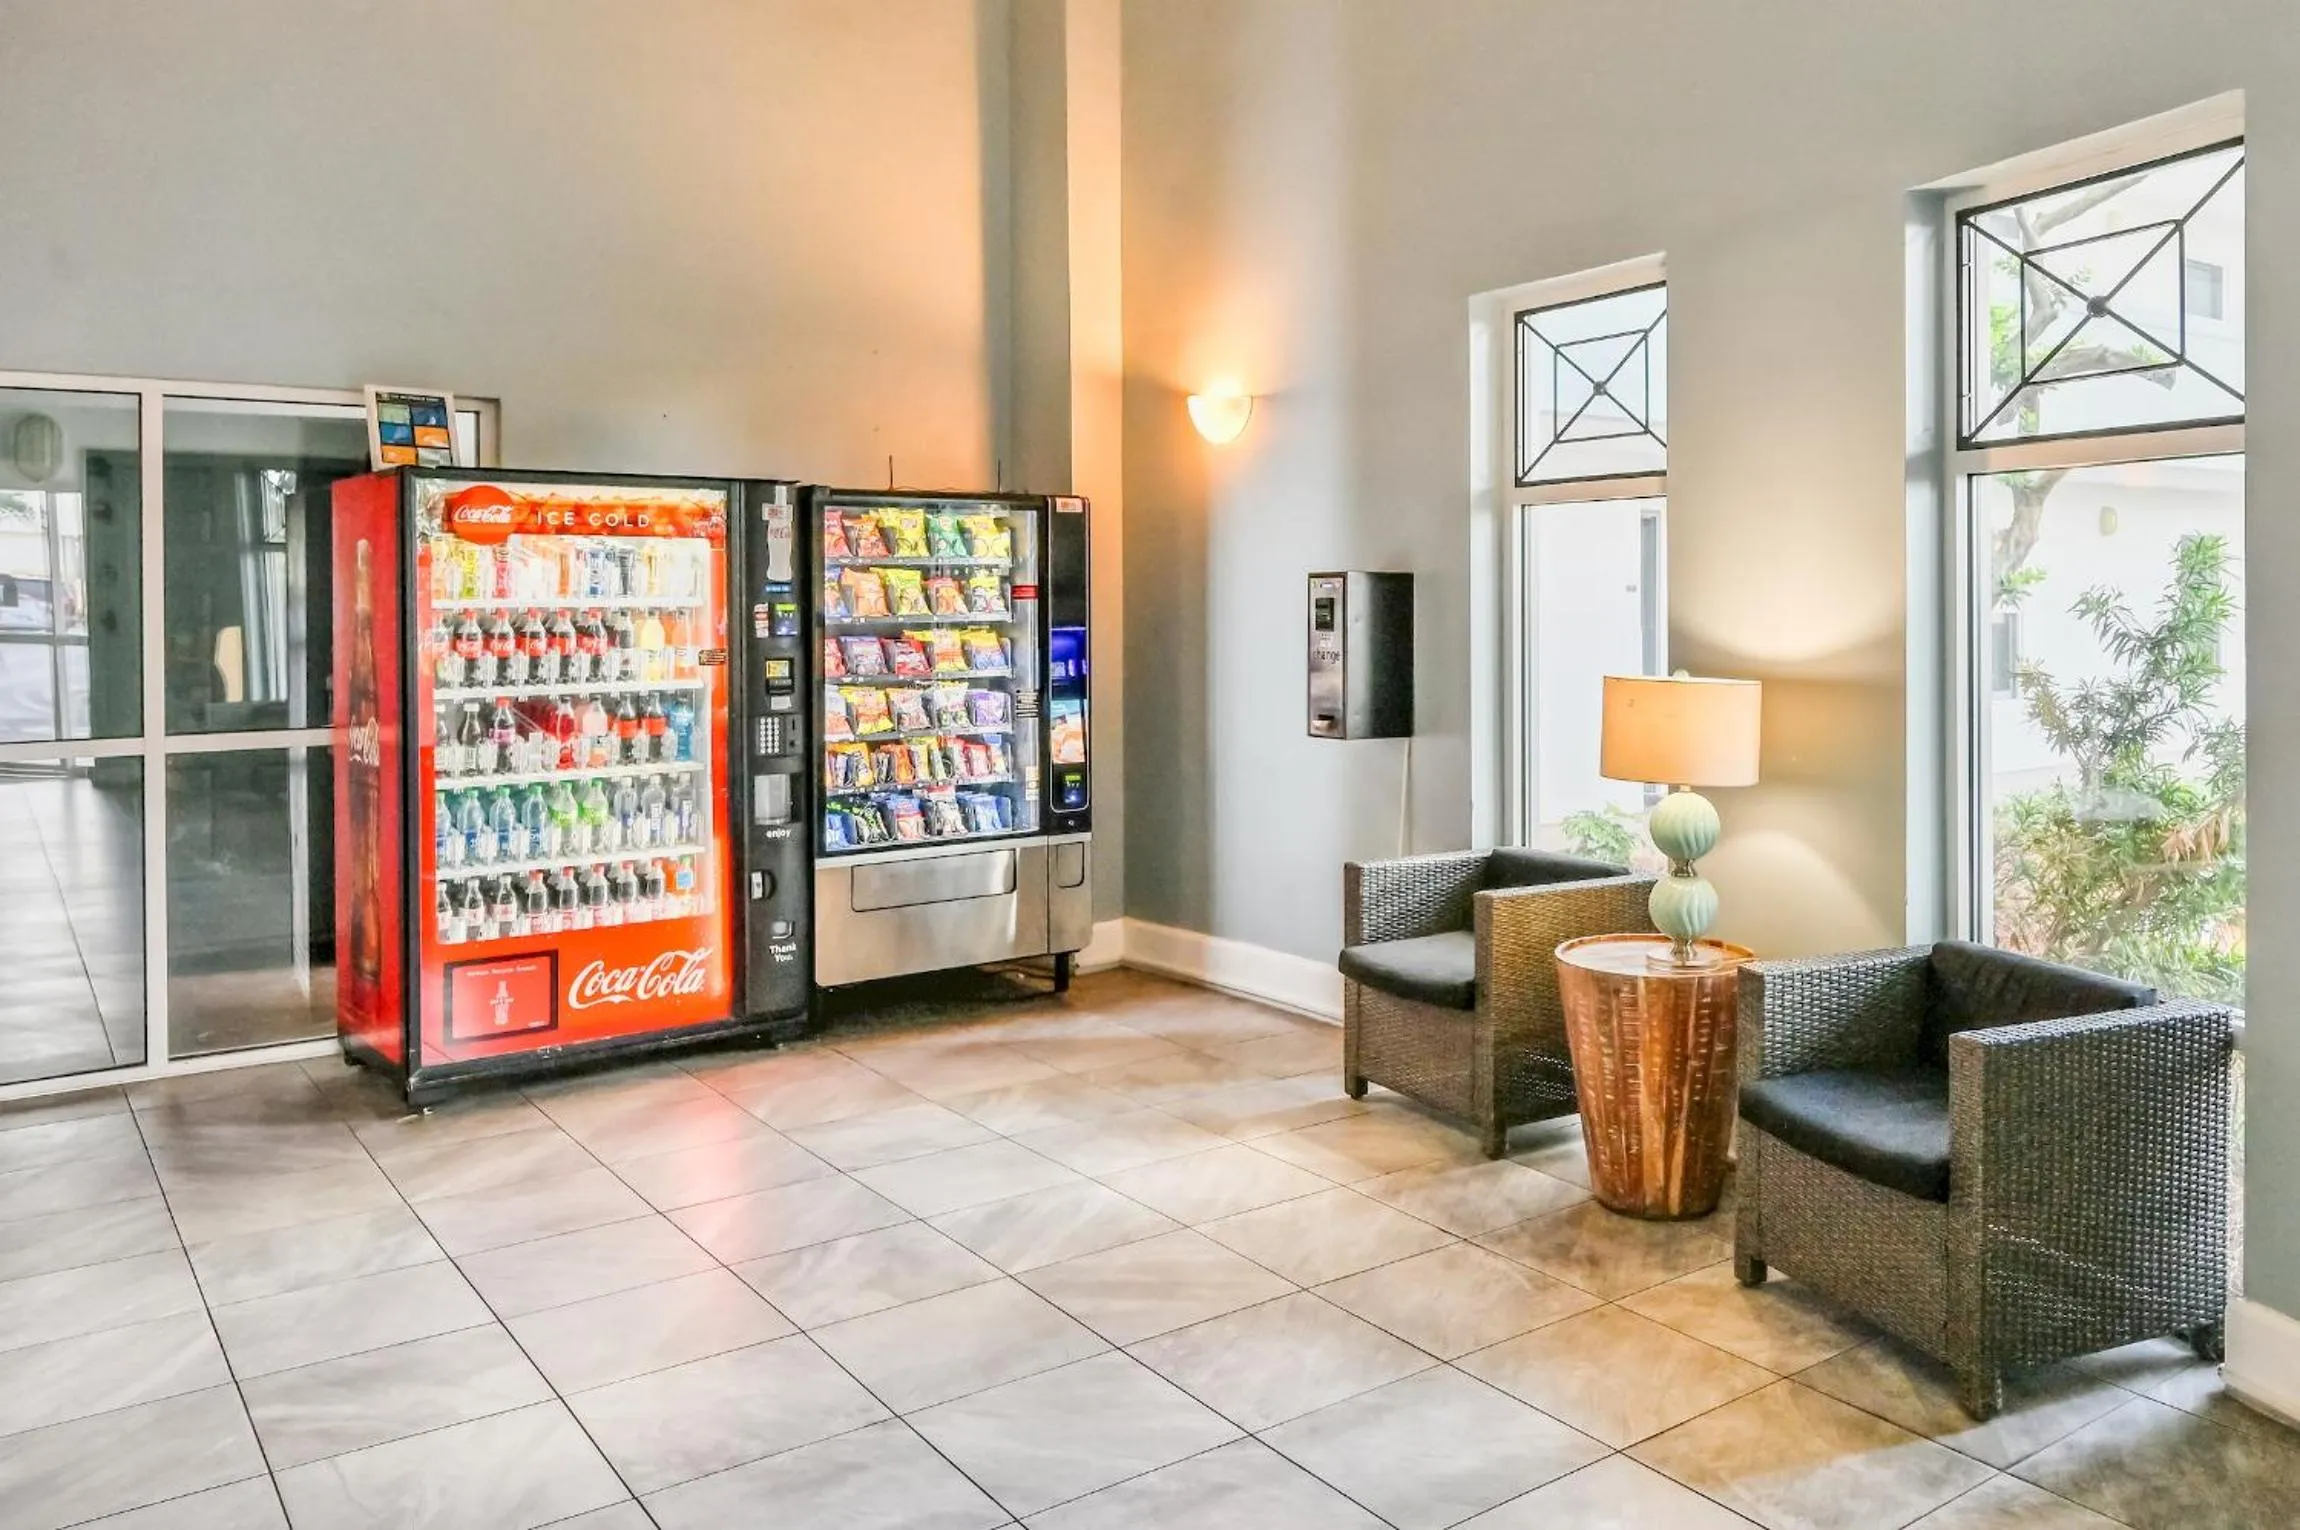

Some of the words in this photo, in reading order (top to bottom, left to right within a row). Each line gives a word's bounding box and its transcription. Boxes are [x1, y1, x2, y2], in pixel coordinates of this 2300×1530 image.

[537, 511, 576, 526] ICE
[588, 512, 651, 527] COLD
[766, 828, 792, 839] enjoy
[769, 941, 797, 954] Thank
[568, 947, 714, 1010] Coca-Cola
